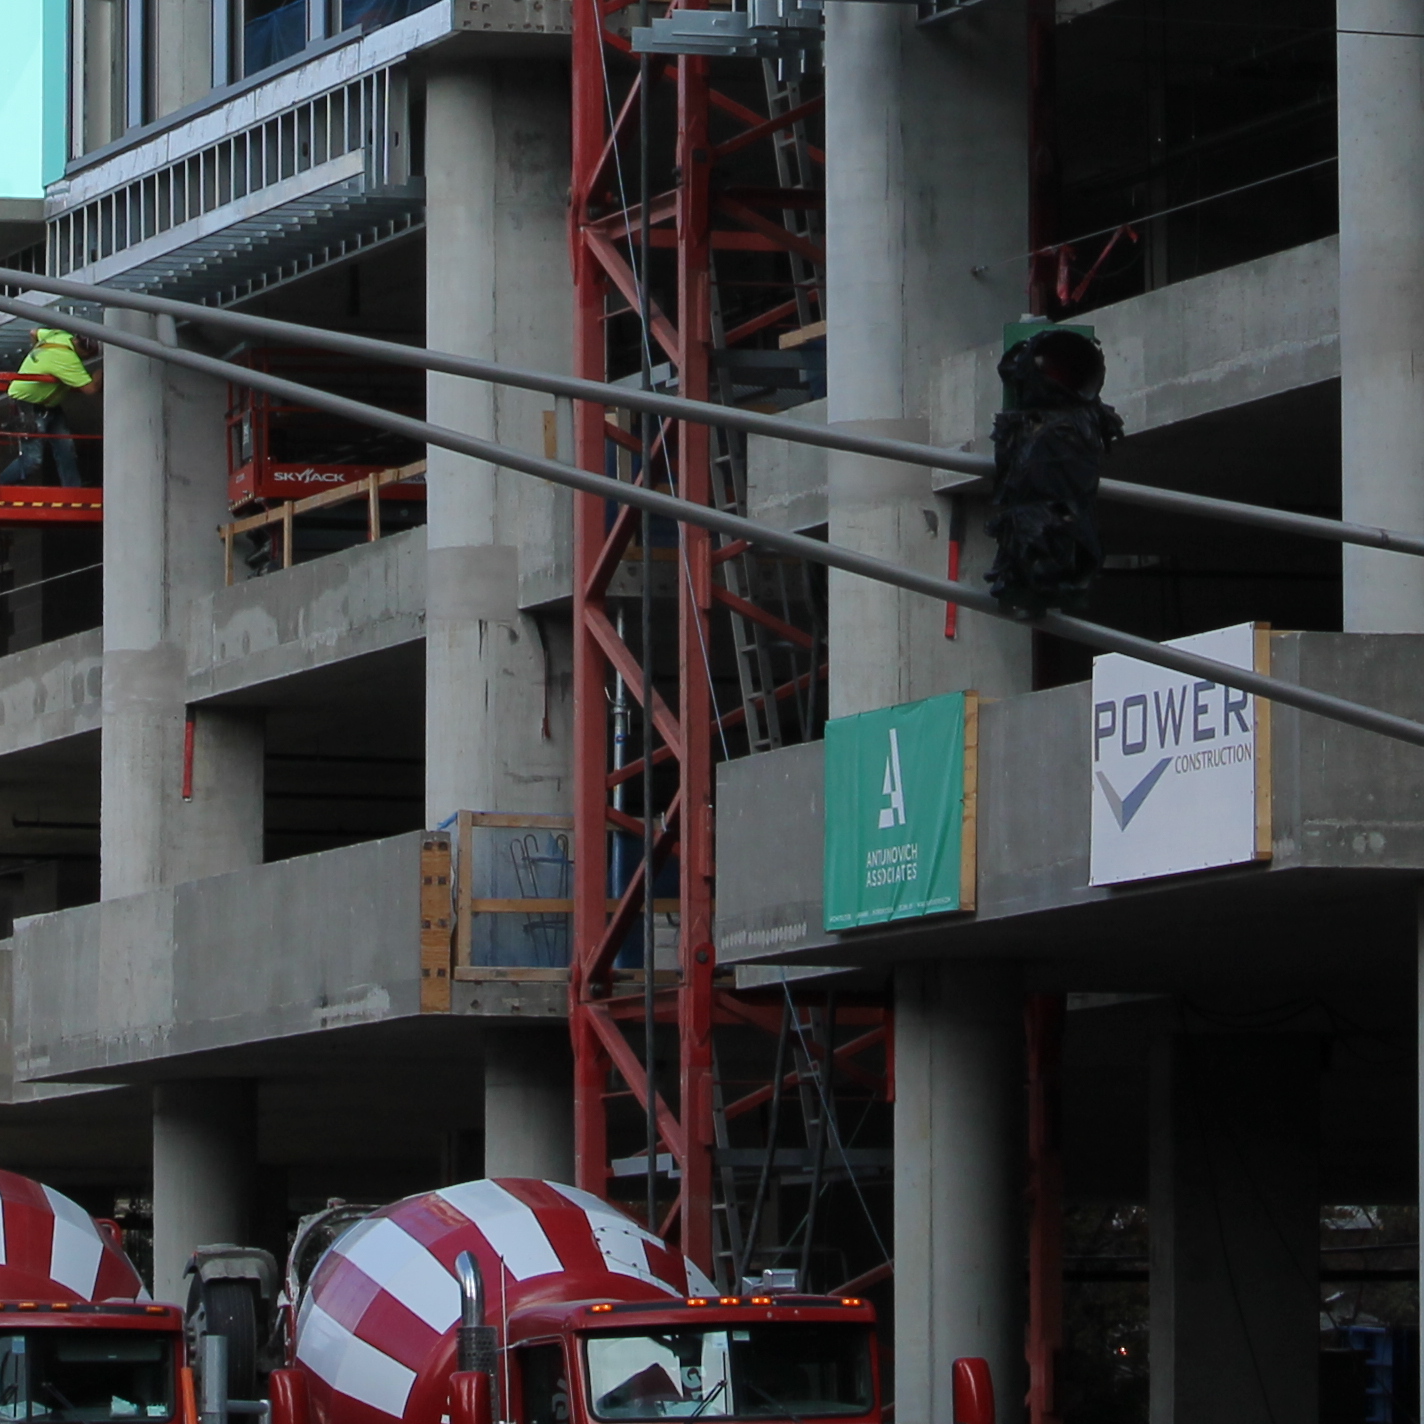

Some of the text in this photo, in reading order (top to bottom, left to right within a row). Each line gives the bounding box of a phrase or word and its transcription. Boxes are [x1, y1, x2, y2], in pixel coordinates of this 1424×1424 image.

[274, 467, 346, 484] SKYJACK
[1094, 680, 1251, 762] POWER
[1174, 743, 1252, 775] CONSTRUCTION
[866, 843, 918, 868] ANTUNOVICH
[866, 863, 918, 888] ASSOCIATES
